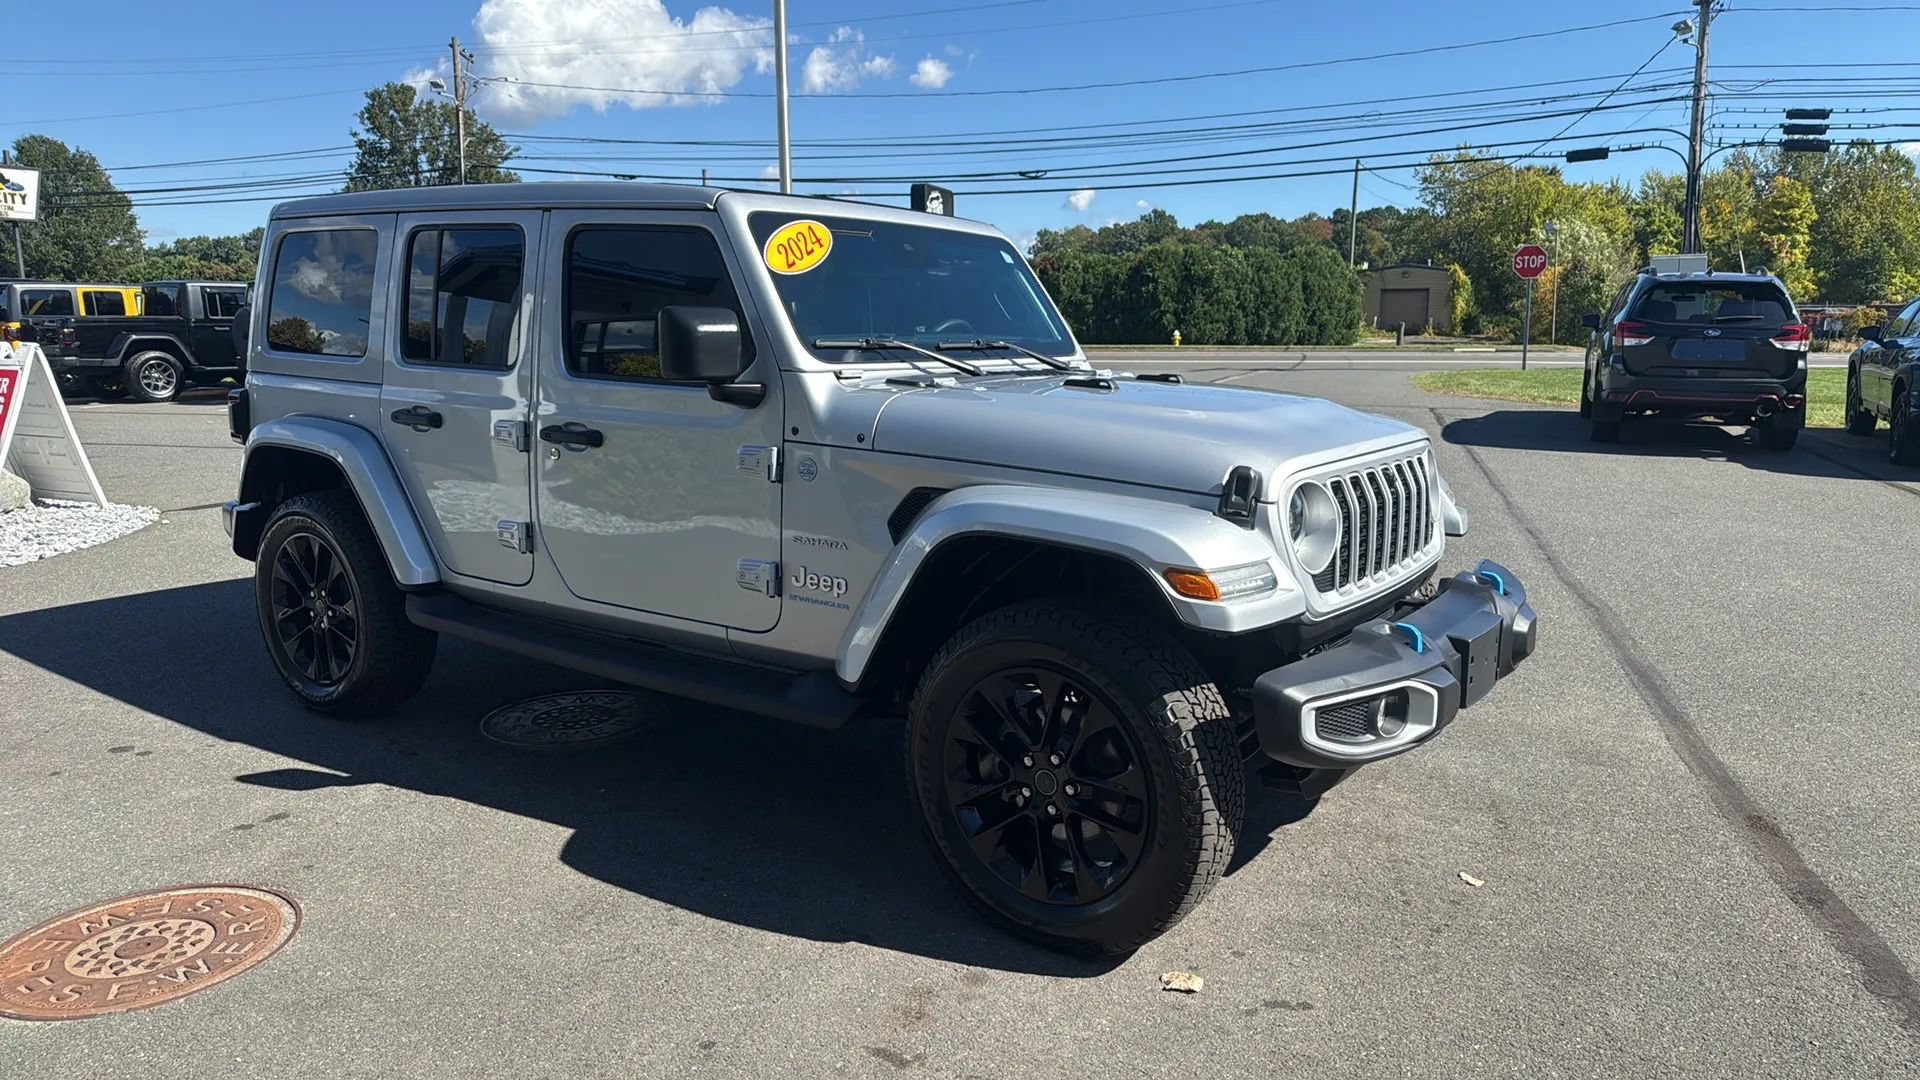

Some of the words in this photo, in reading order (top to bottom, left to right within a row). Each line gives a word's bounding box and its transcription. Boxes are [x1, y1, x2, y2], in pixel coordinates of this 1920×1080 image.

[0, 191, 28, 206] ITY
[776, 225, 824, 269] 2024
[1515, 255, 1545, 269] STOP
[792, 535, 849, 551] SAHARA
[791, 565, 848, 599] Jeep
[798, 594, 850, 611] WRANGLER
